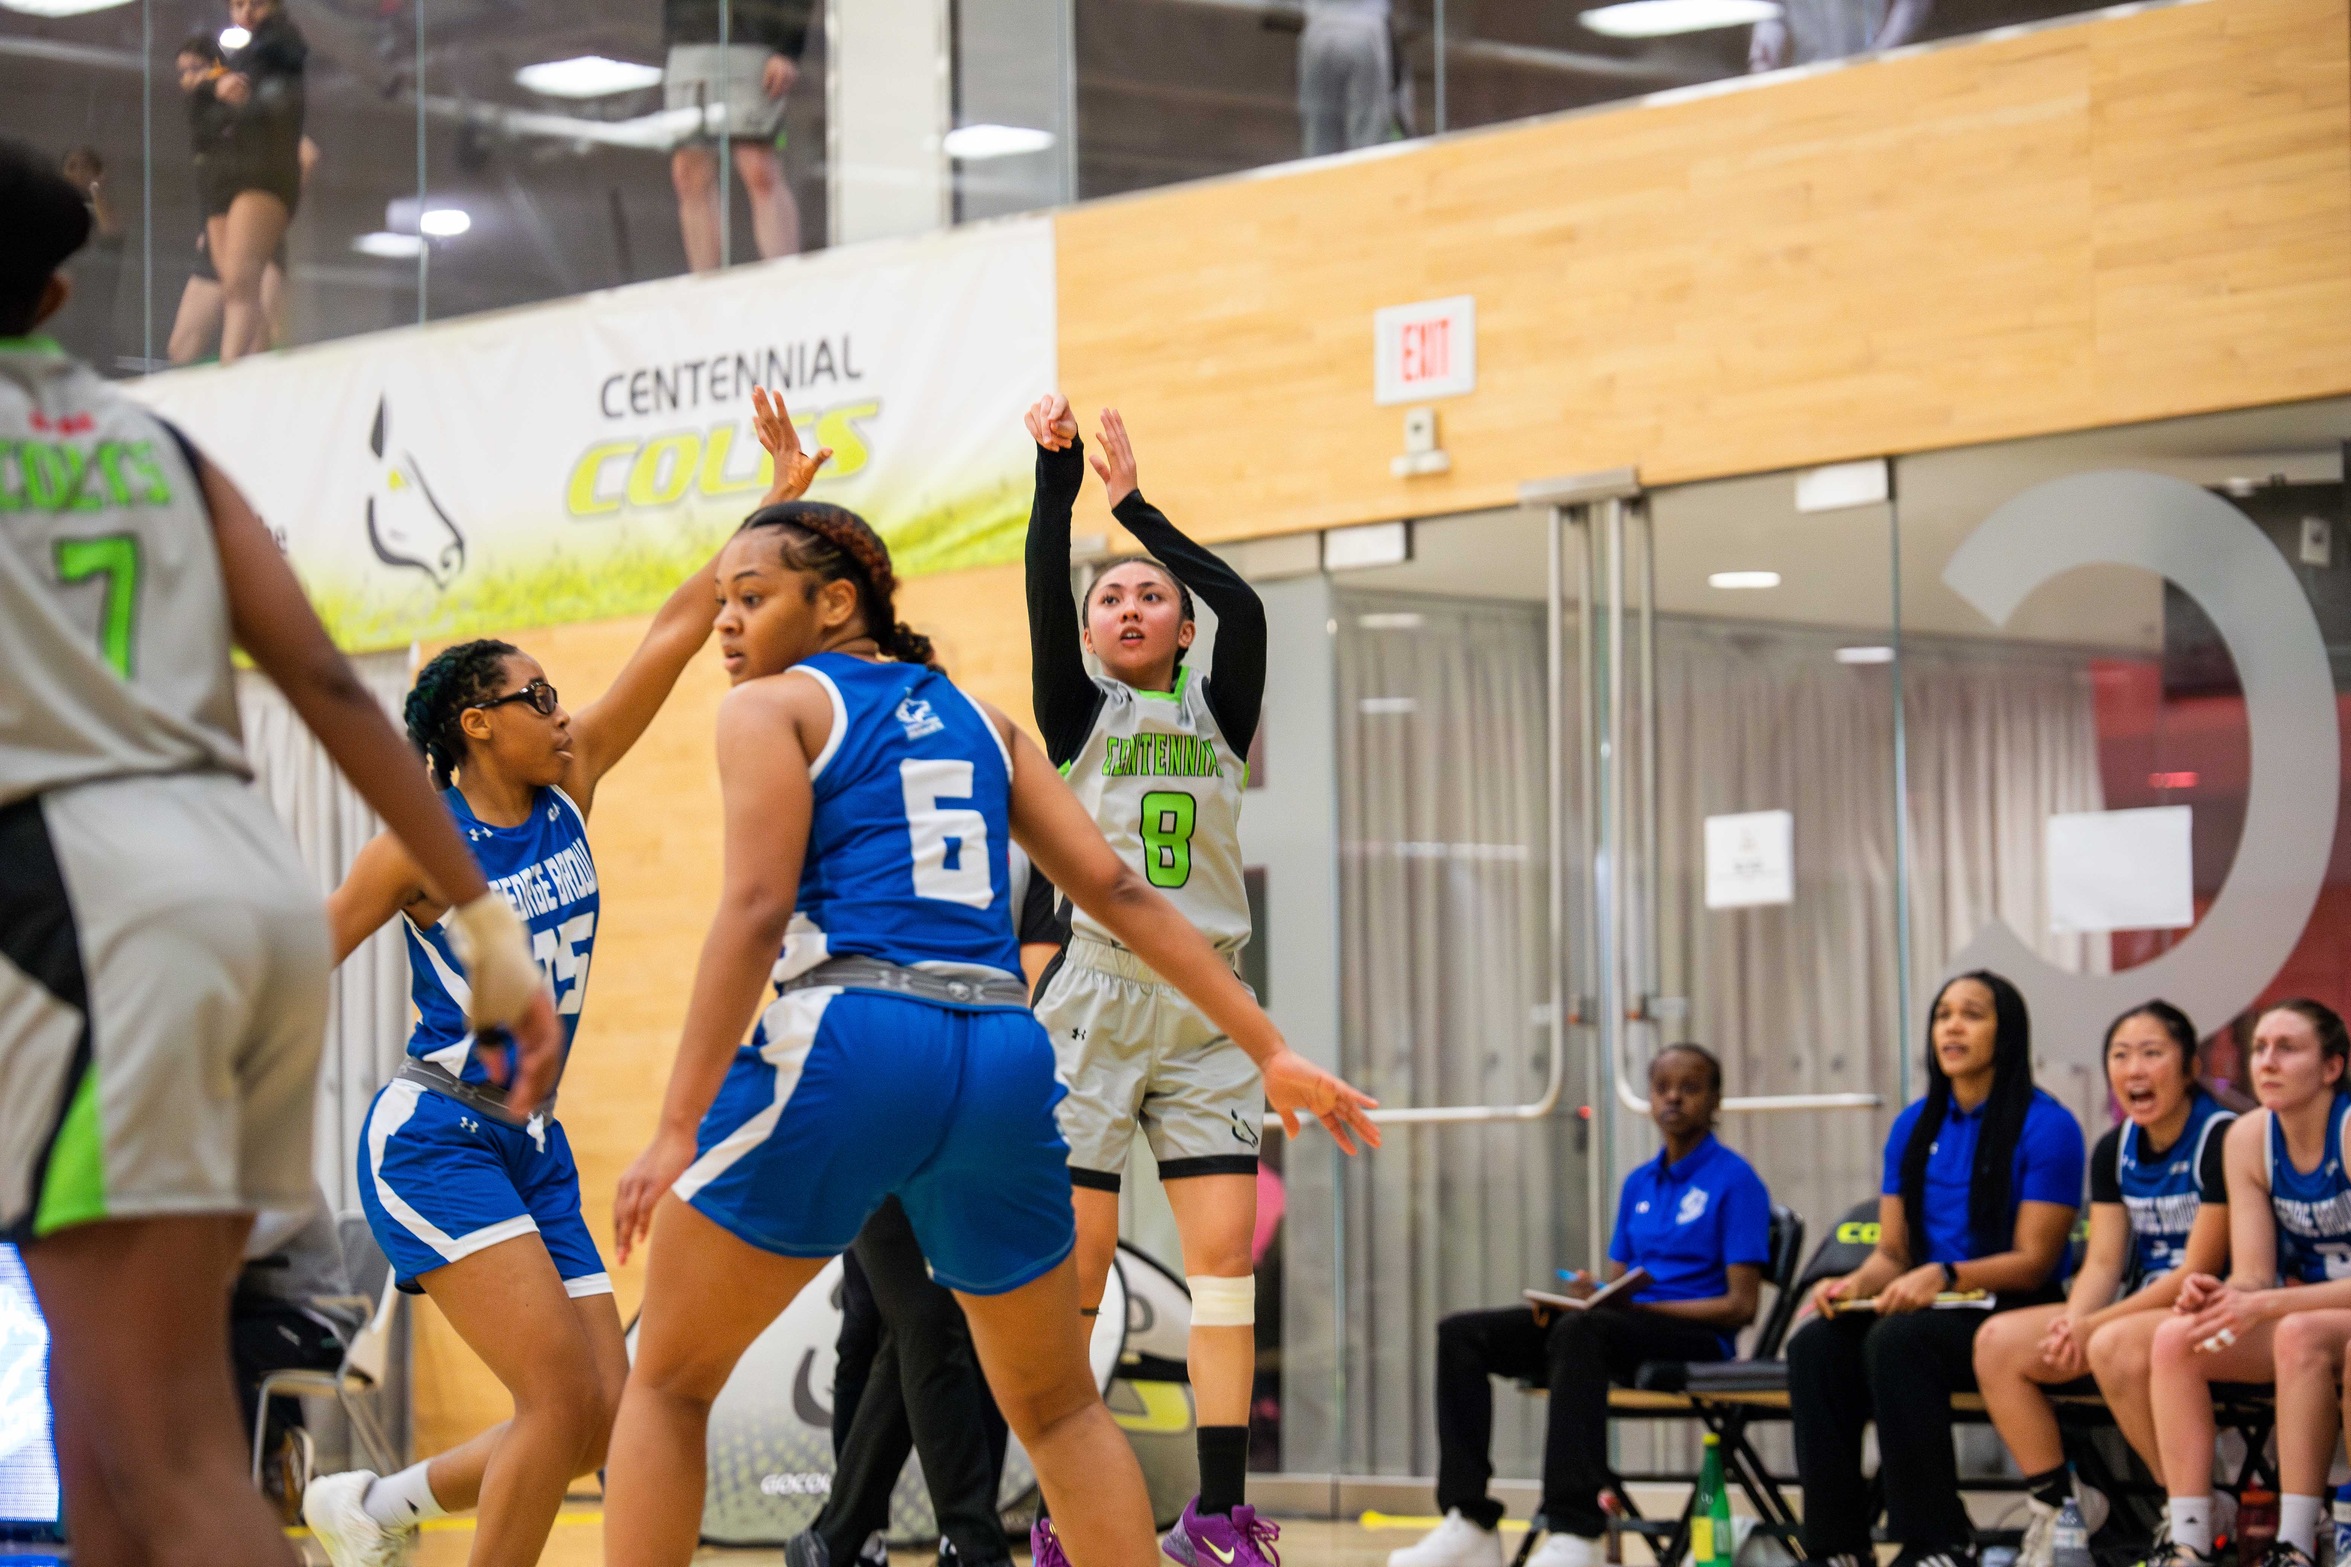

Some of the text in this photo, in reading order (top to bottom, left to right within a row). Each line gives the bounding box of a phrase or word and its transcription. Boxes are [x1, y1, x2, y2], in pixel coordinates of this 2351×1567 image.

[600, 334, 863, 418] CENTENNIAL
[1401, 316, 1451, 384] EXIT
[53, 530, 143, 684] 7
[1101, 732, 1224, 778] CENTENNIA
[542, 836, 599, 907] BROW
[898, 757, 995, 911] 6
[1139, 790, 1197, 889] 8
